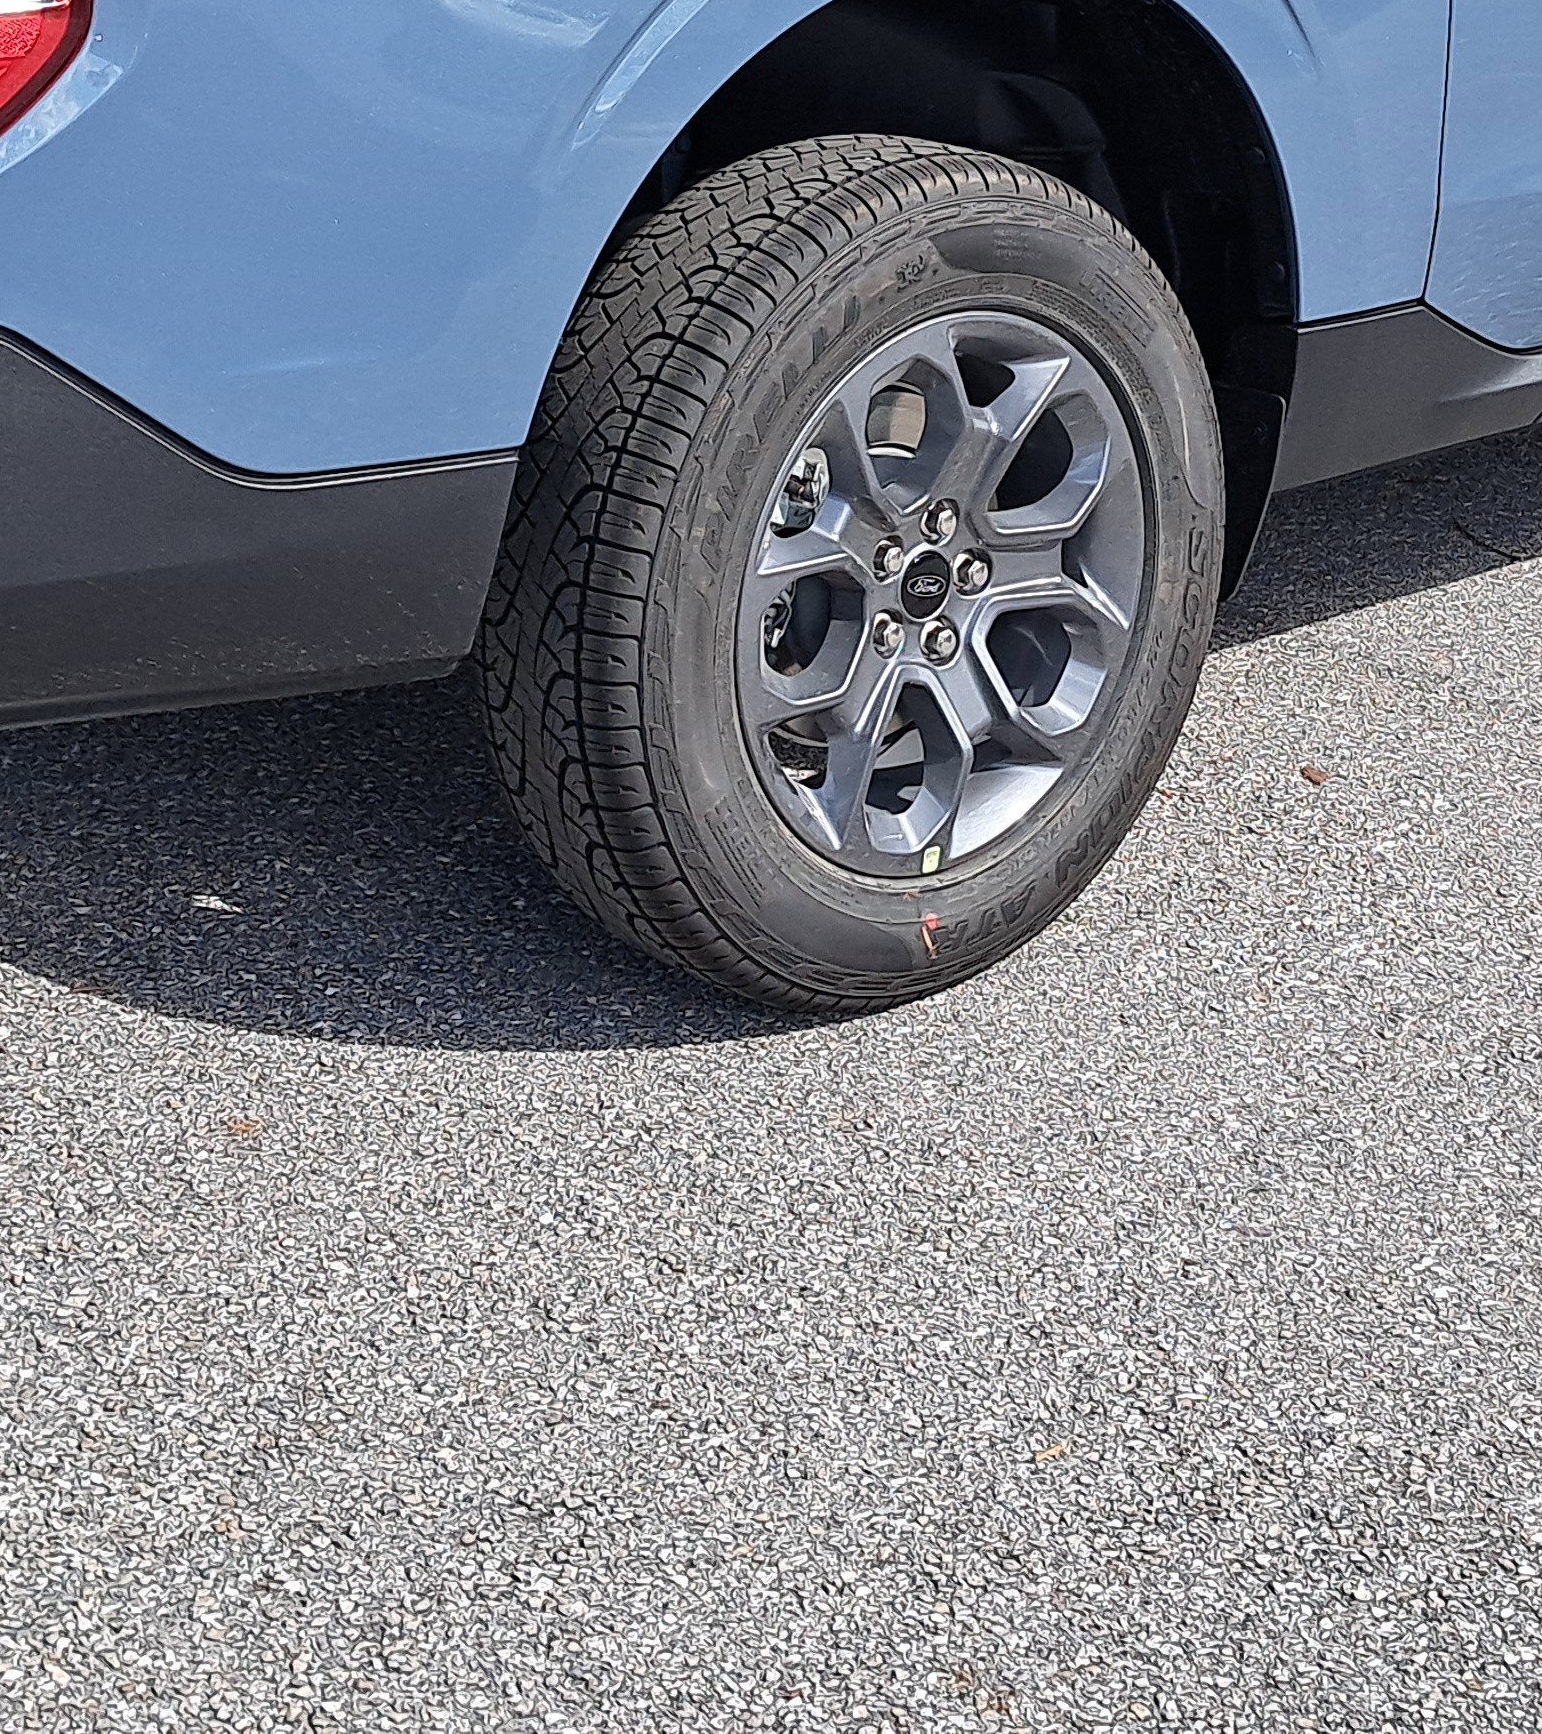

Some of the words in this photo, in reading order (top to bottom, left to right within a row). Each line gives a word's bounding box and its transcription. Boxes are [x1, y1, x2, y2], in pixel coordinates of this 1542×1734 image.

[700, 292, 860, 572] PIRELLI
[914, 578, 941, 593] Ford
[1056, 524, 1208, 888] SCORPION
